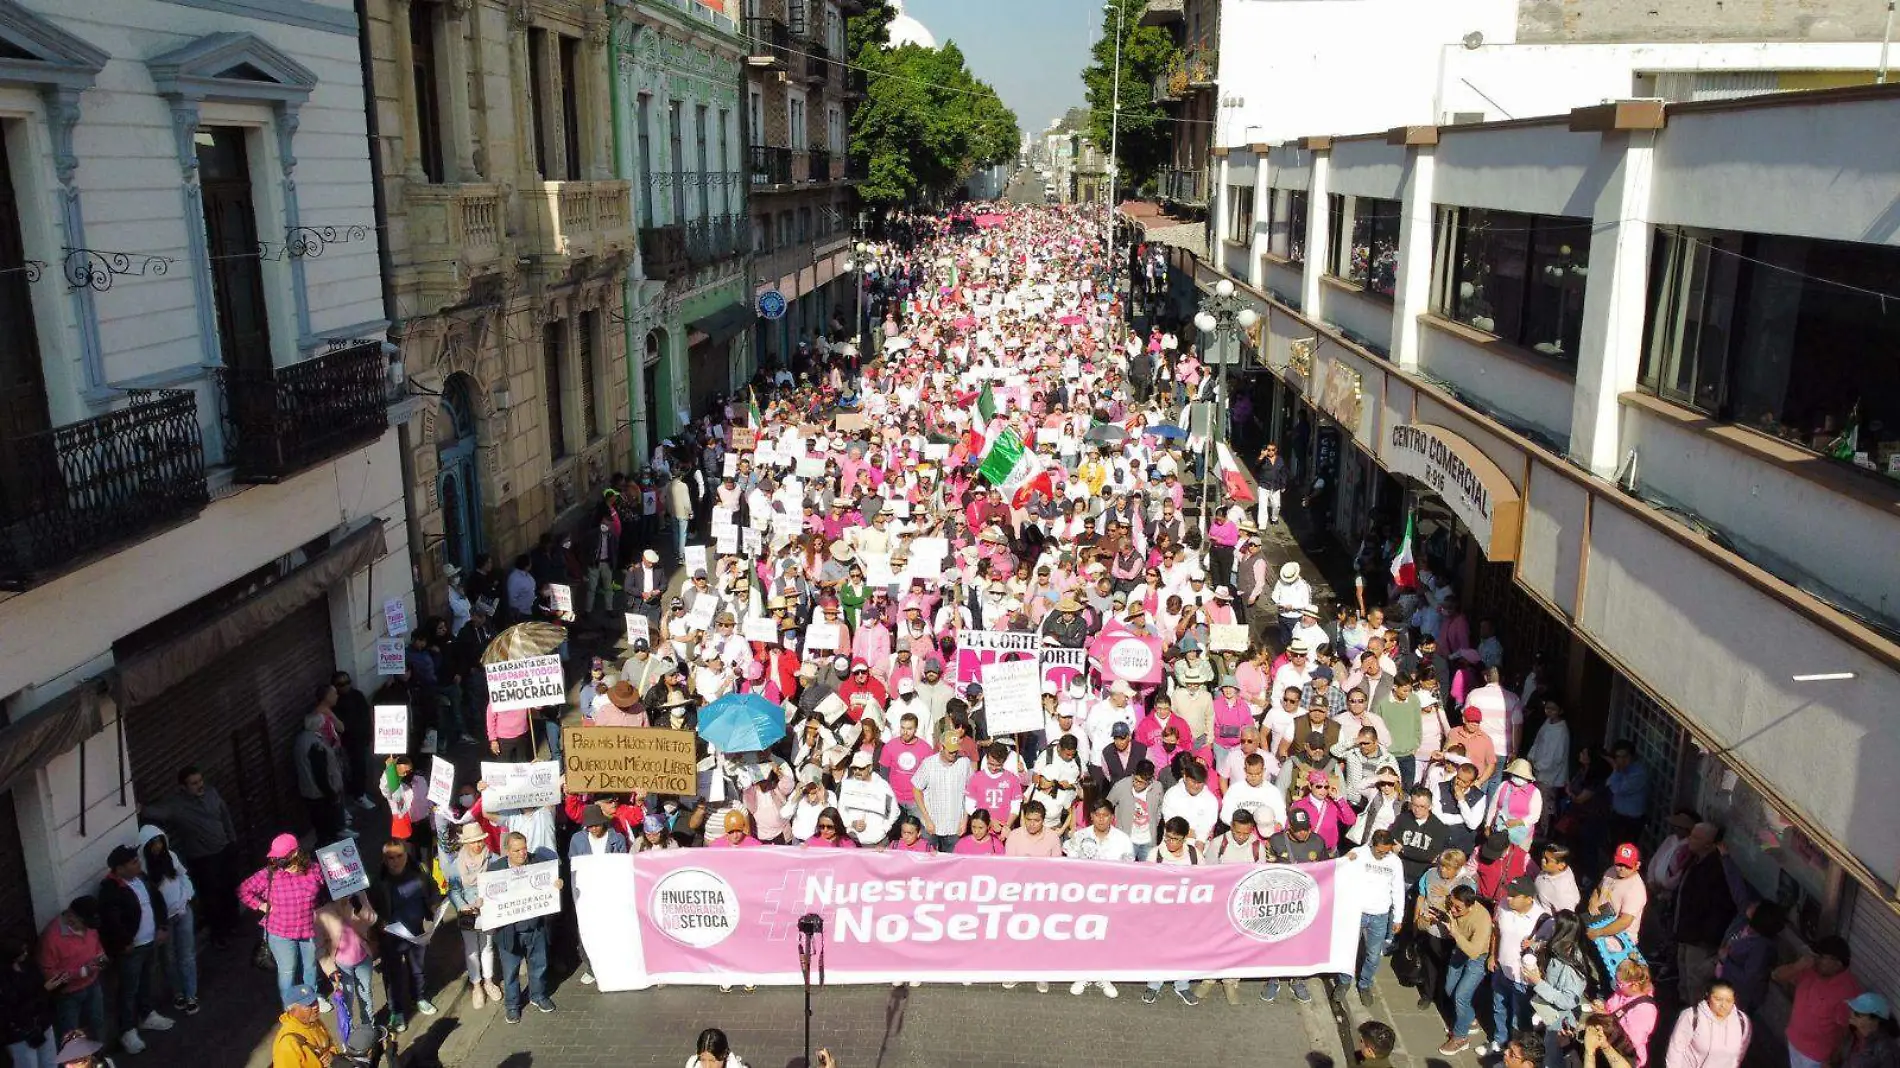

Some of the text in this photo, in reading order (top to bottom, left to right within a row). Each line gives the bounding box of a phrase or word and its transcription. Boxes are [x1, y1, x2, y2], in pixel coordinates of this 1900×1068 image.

[1393, 426, 1488, 519] CENTRO COMERCIAL
[990, 634, 1039, 649] CORTE
[487, 665, 497, 673] LA
[536, 659, 547, 667] DE
[548, 657, 559, 665] UN
[508, 670, 529, 680] PARA
[530, 666, 559, 676] TODOS
[501, 675, 551, 689] ESO ES LA
[491, 683, 564, 703] DEMOCRACIA
[584, 775, 595, 788] Y
[986, 789, 1003, 808] T
[498, 893, 553, 910] DEMOCRACIA
[661, 890, 725, 905] #NUESTRA
[833, 904, 1109, 943] NoSeToca
